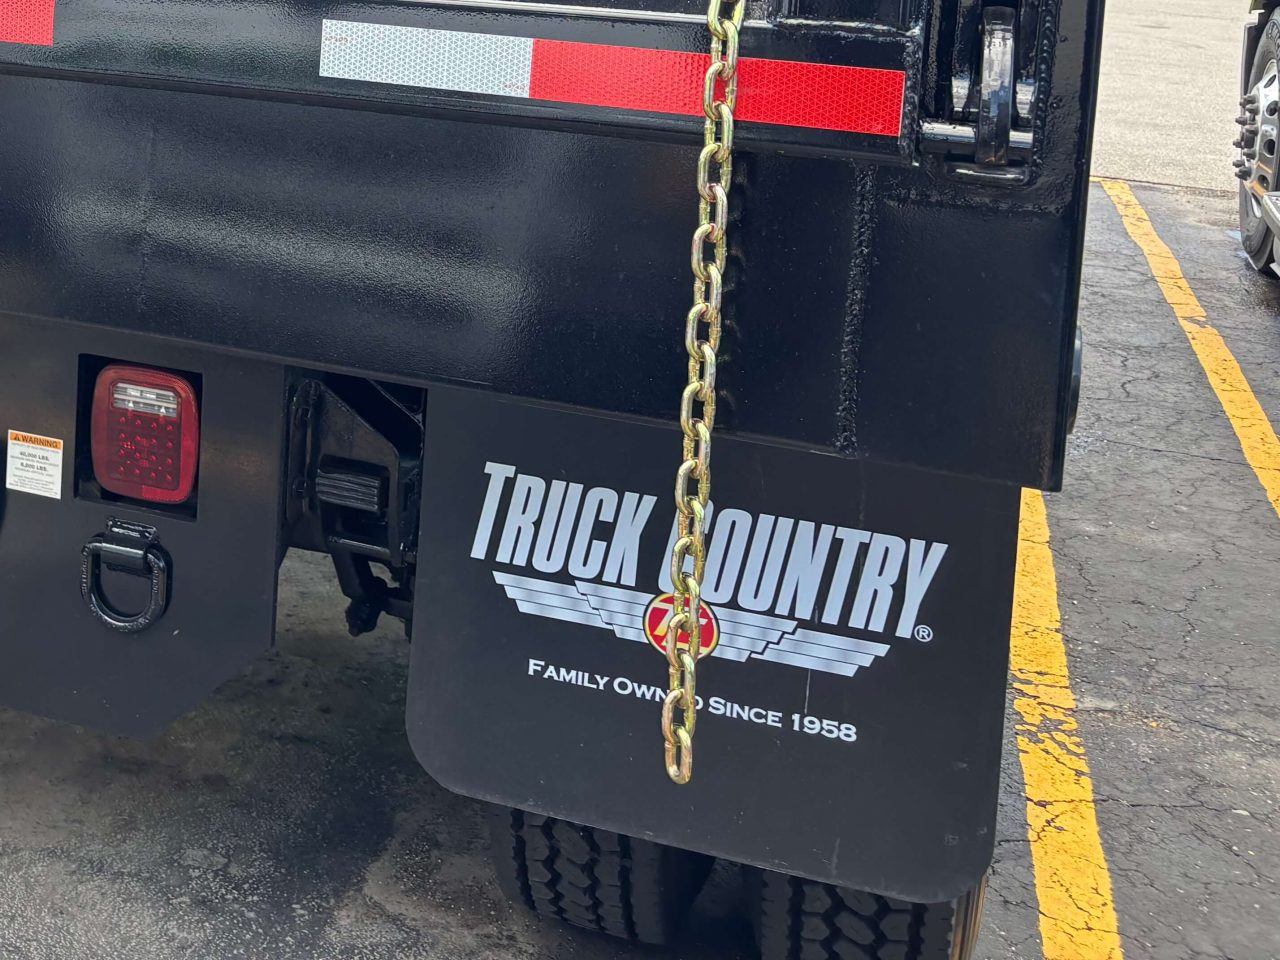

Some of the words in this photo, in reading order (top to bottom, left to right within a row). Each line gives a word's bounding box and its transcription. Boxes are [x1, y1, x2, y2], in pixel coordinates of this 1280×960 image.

[21, 434, 58, 448] WARNING
[470, 461, 658, 587] TRUCK
[527, 658, 610, 690] FAMILY
[613, 677, 704, 710] OWN
[708, 696, 783, 728] SINCE
[791, 713, 857, 742] 1958
